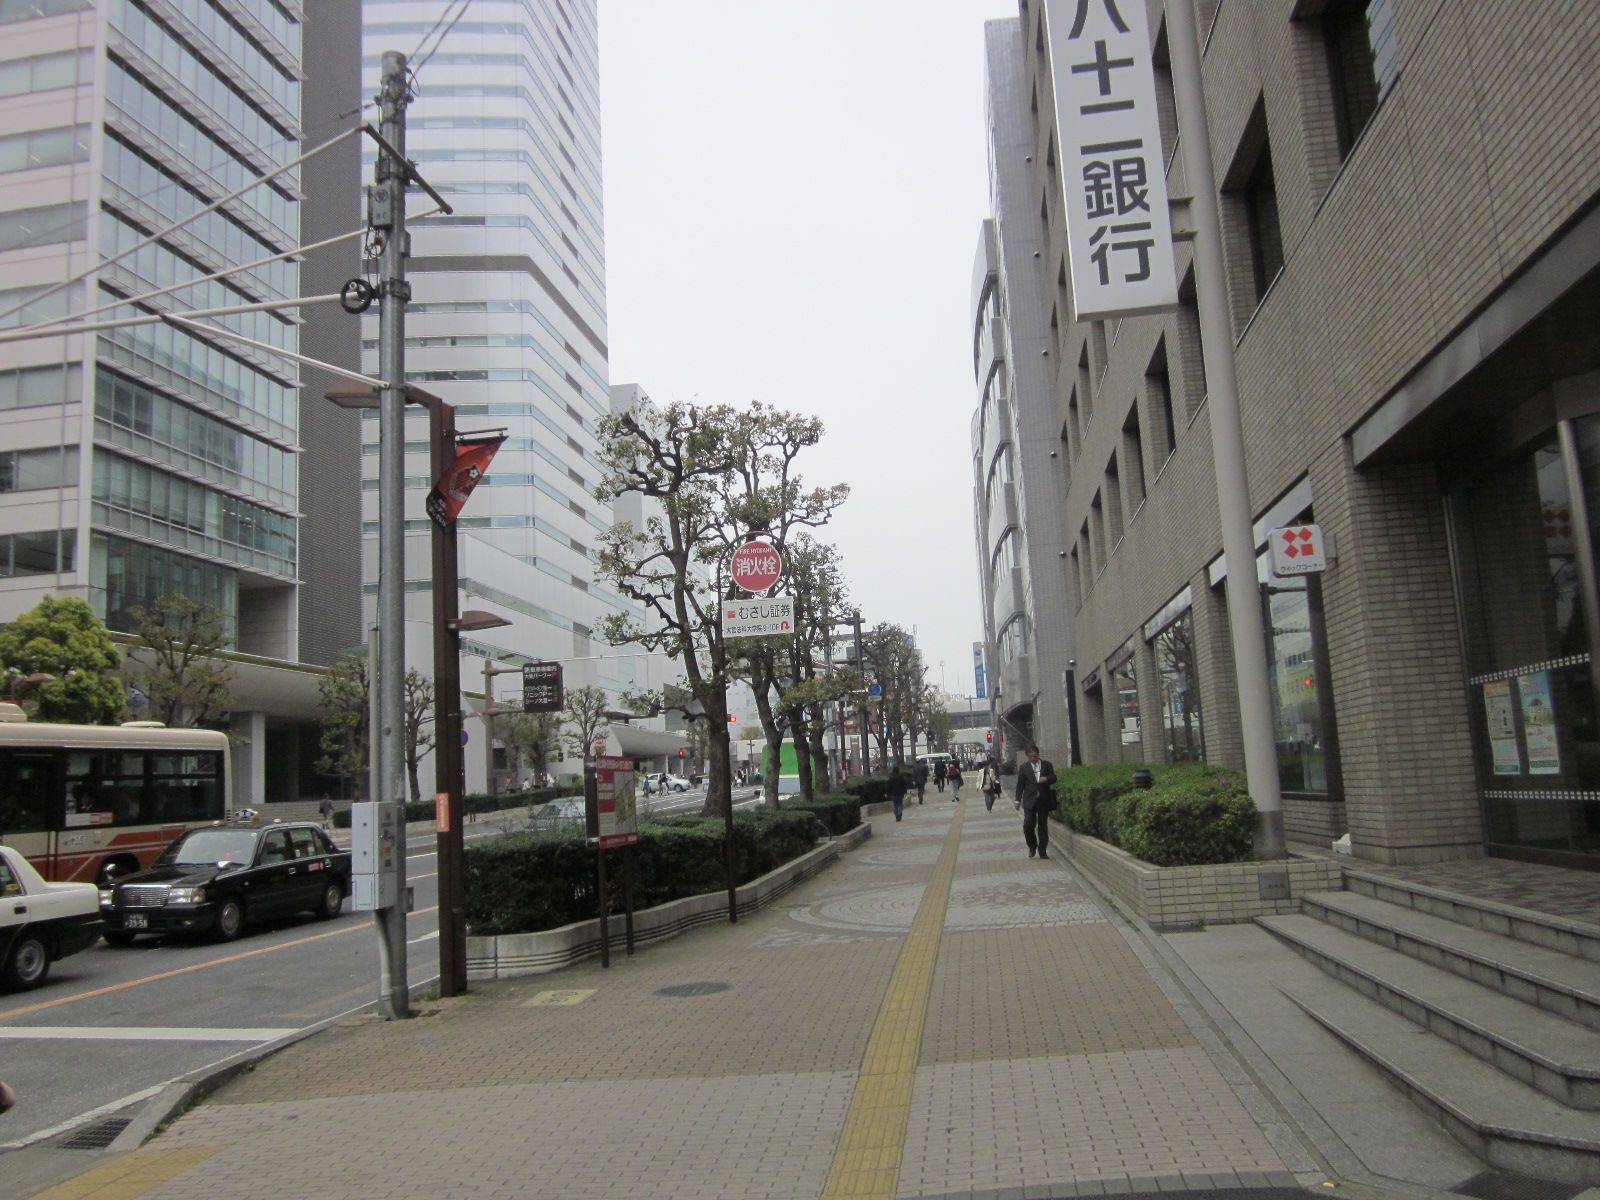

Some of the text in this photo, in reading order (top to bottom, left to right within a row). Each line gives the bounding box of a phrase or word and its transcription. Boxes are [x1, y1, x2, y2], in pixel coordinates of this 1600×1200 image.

[1067, 0, 1155, 287] 八十二銀行
[736, 556, 777, 577] 消火栓
[738, 604, 791, 620] むさし証券
